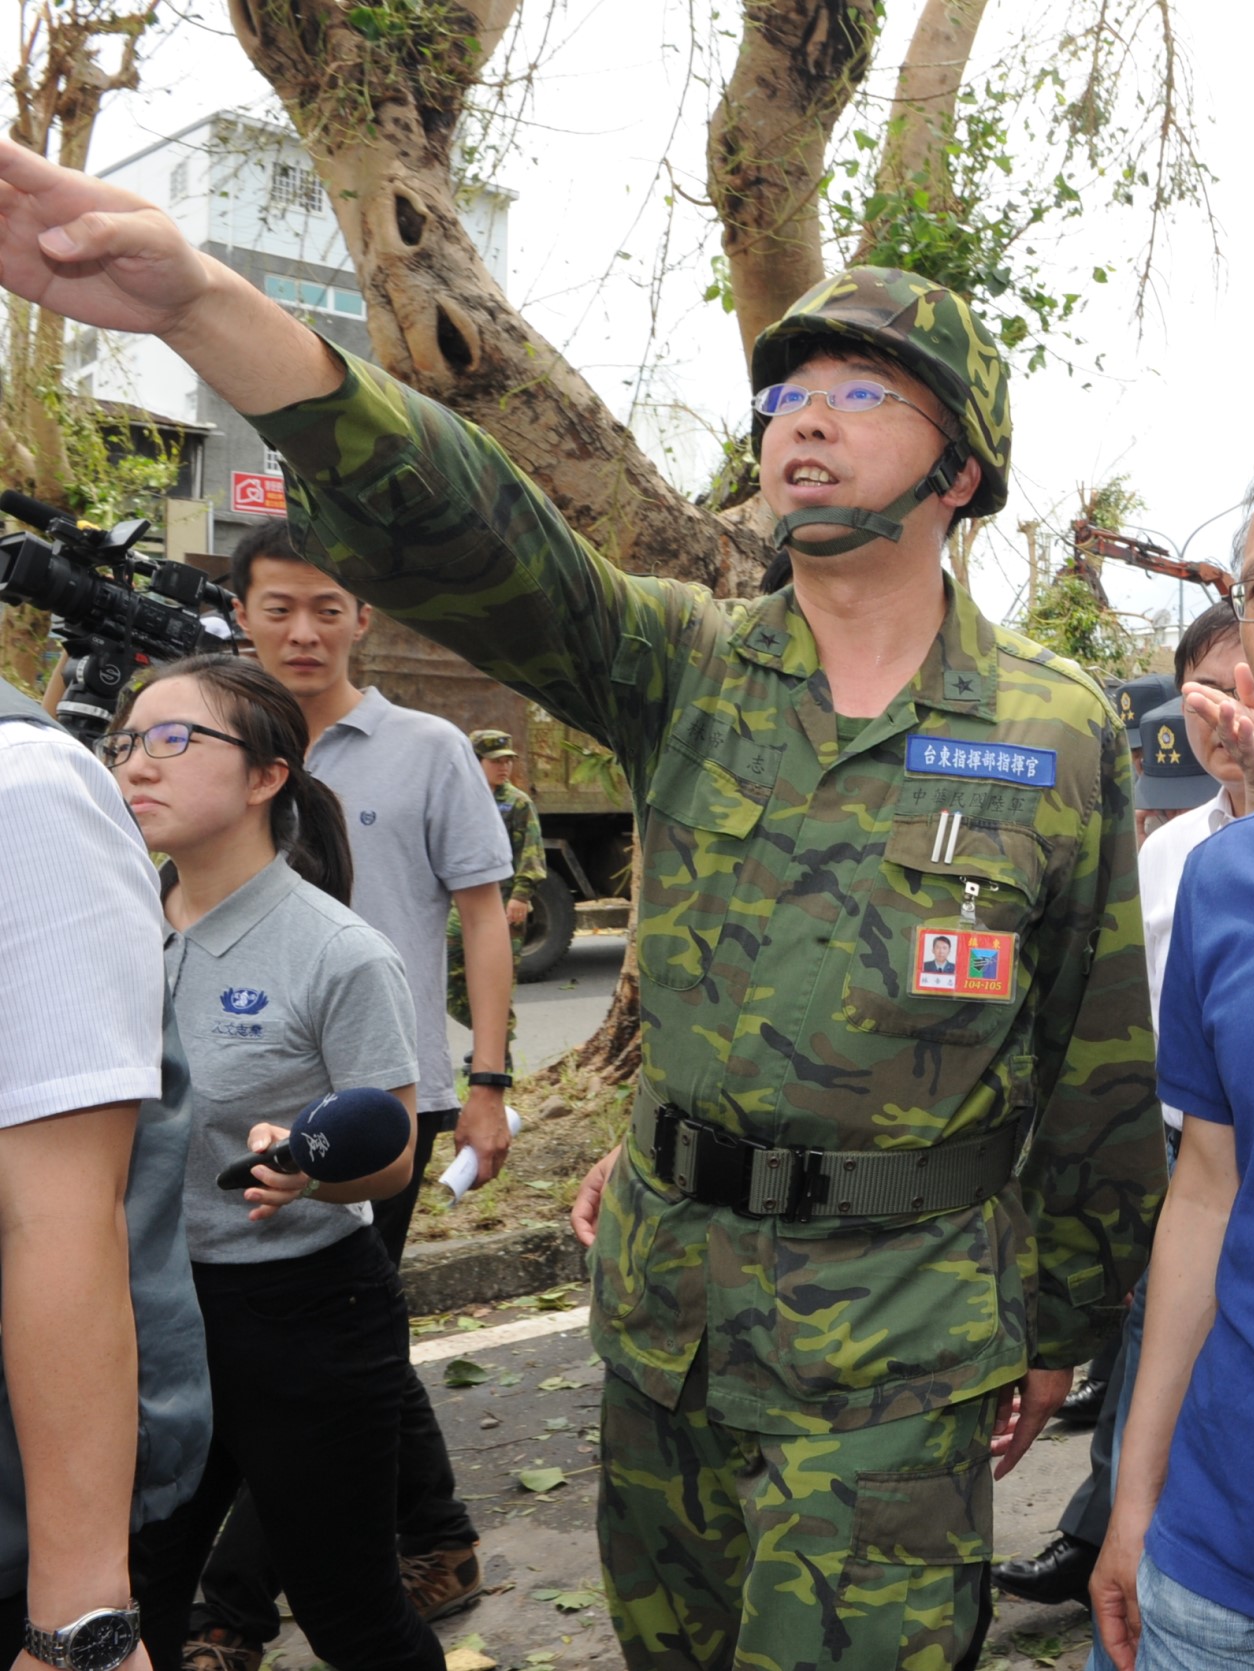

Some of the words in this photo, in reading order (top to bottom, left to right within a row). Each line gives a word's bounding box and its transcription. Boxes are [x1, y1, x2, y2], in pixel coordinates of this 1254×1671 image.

[923, 744, 1039, 778] 台東指揮部指揮官
[963, 980, 1002, 991] 104-105
